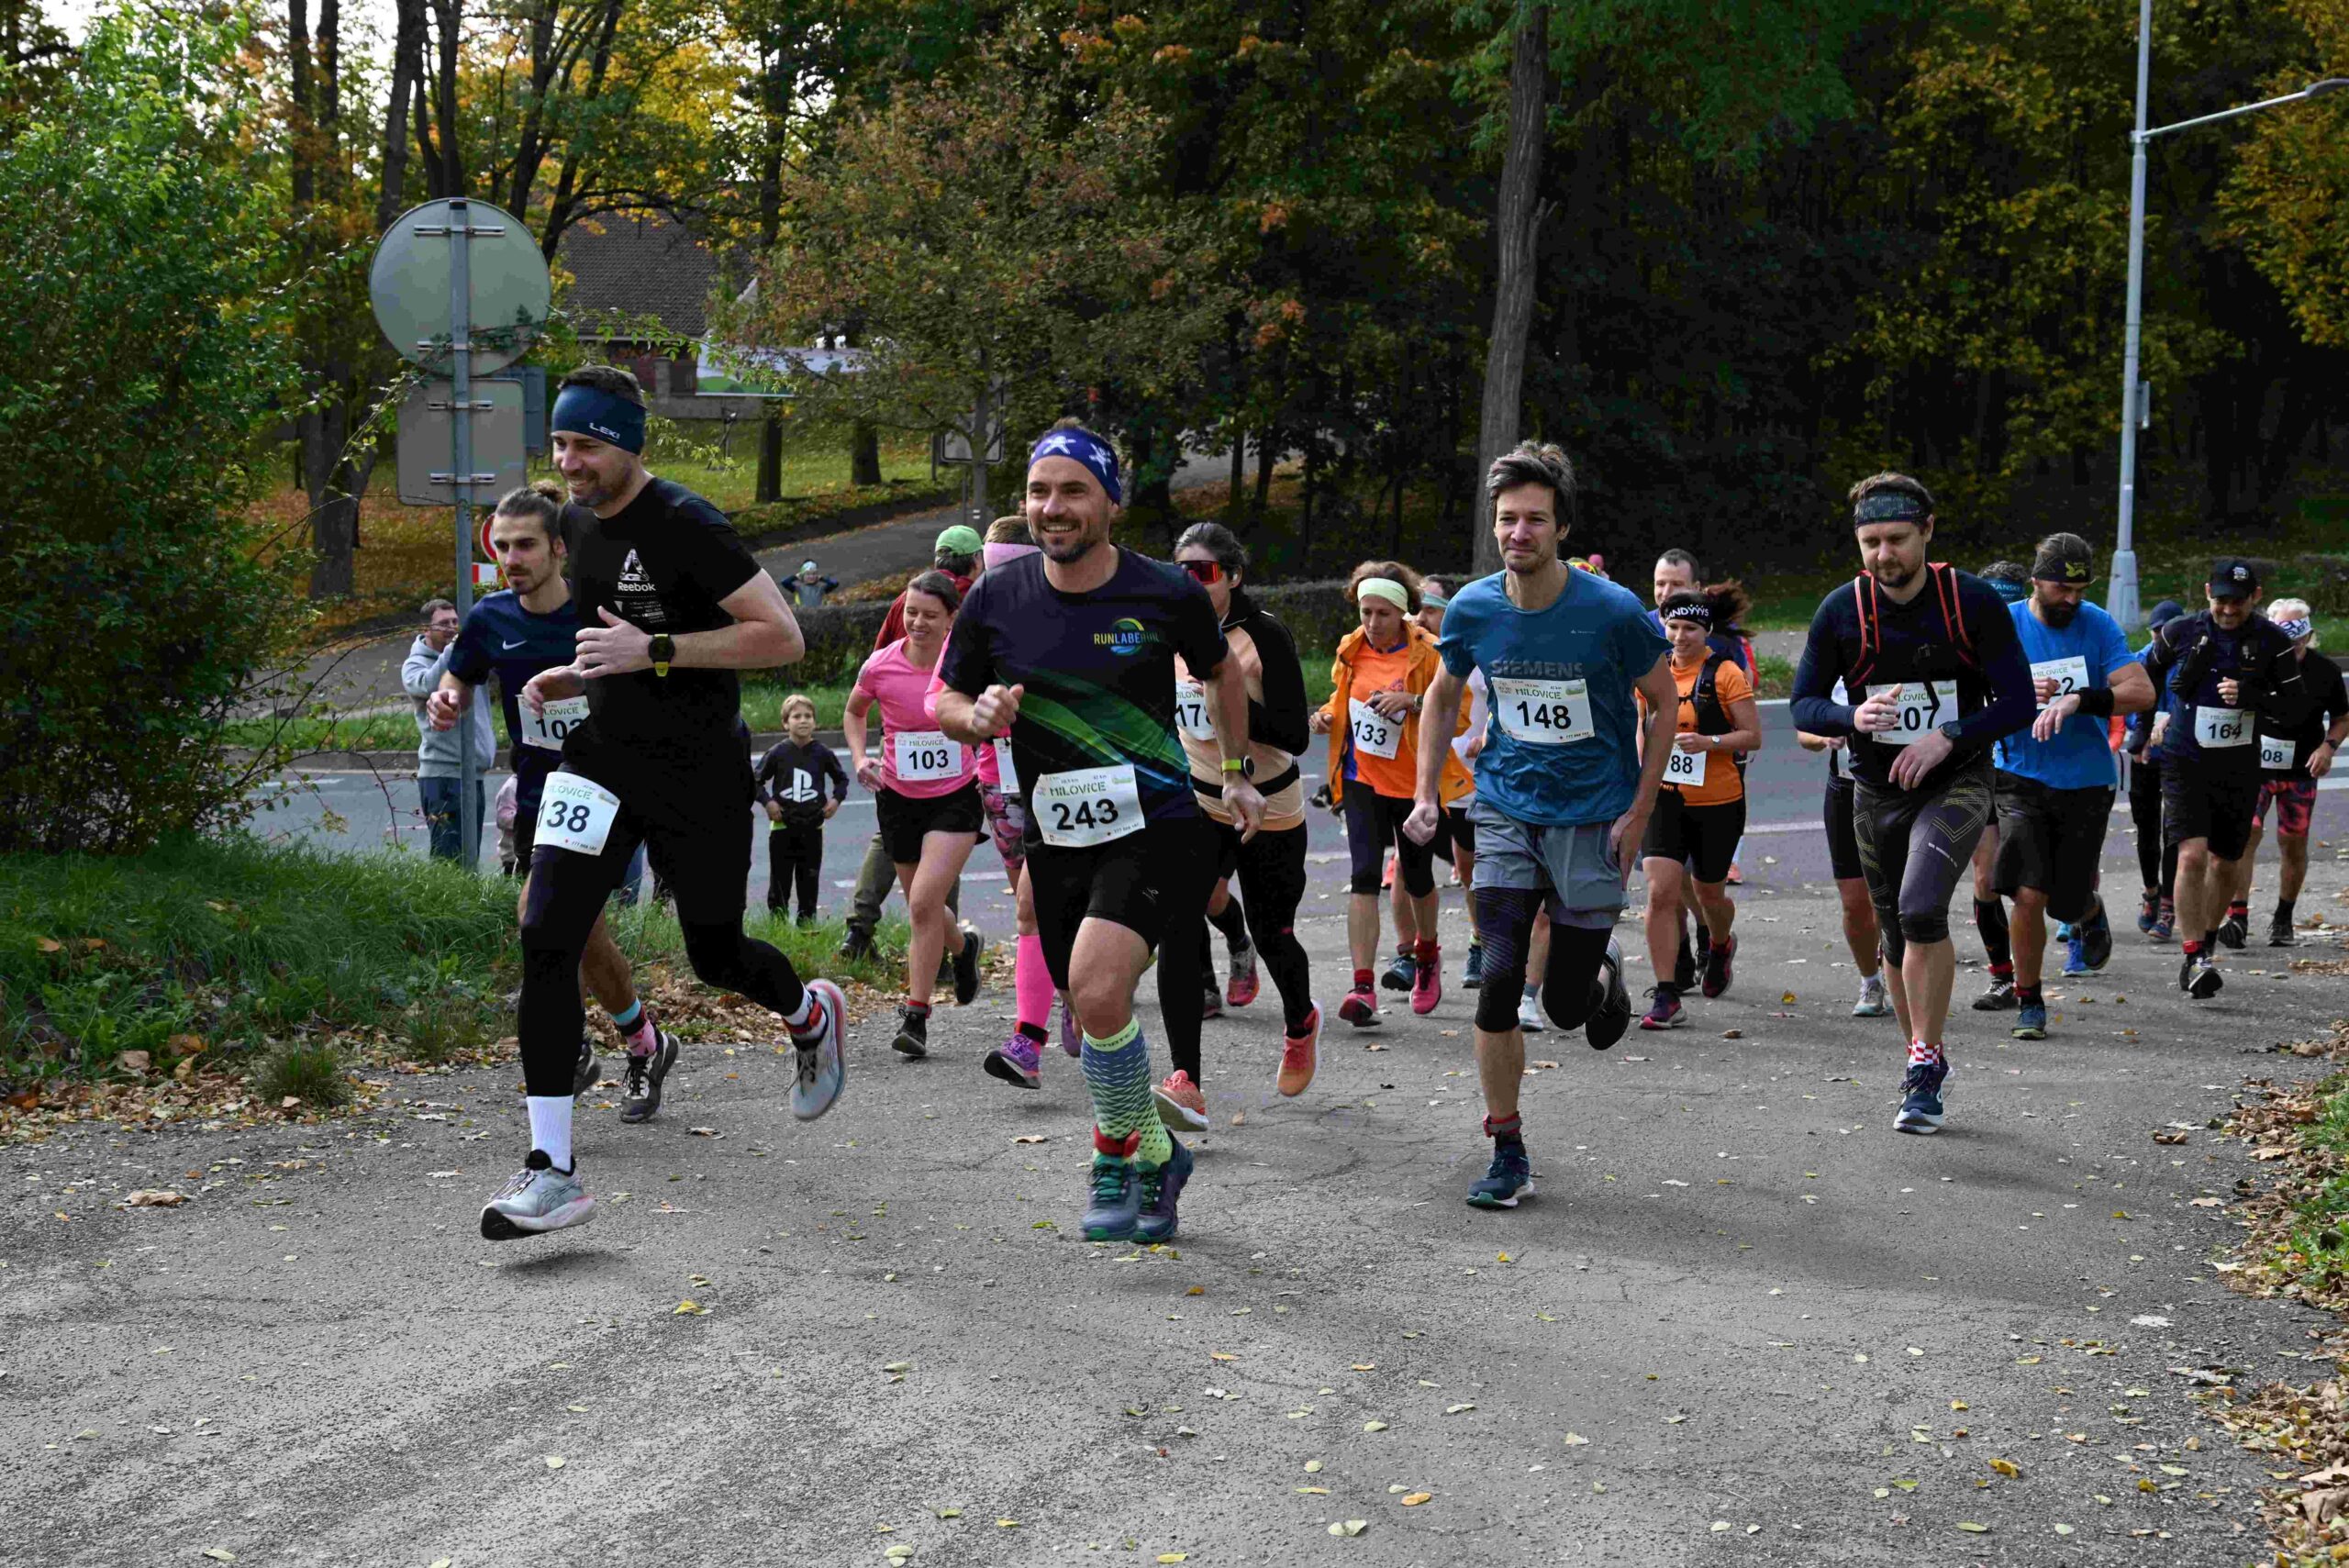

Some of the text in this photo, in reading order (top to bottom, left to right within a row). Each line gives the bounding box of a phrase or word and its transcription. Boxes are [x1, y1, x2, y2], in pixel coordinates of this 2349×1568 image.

[589, 422, 620, 439] LEKI
[618, 581, 656, 592] Reebok
[1491, 660, 1584, 678] SIEMENS
[1517, 700, 1572, 729] 148
[1354, 720, 1387, 746] 133
[2208, 723, 2243, 740] 164
[908, 749, 949, 770] 103
[1671, 755, 1693, 773] 88
[537, 799, 590, 833] 138
[1051, 798, 1119, 830] 243
